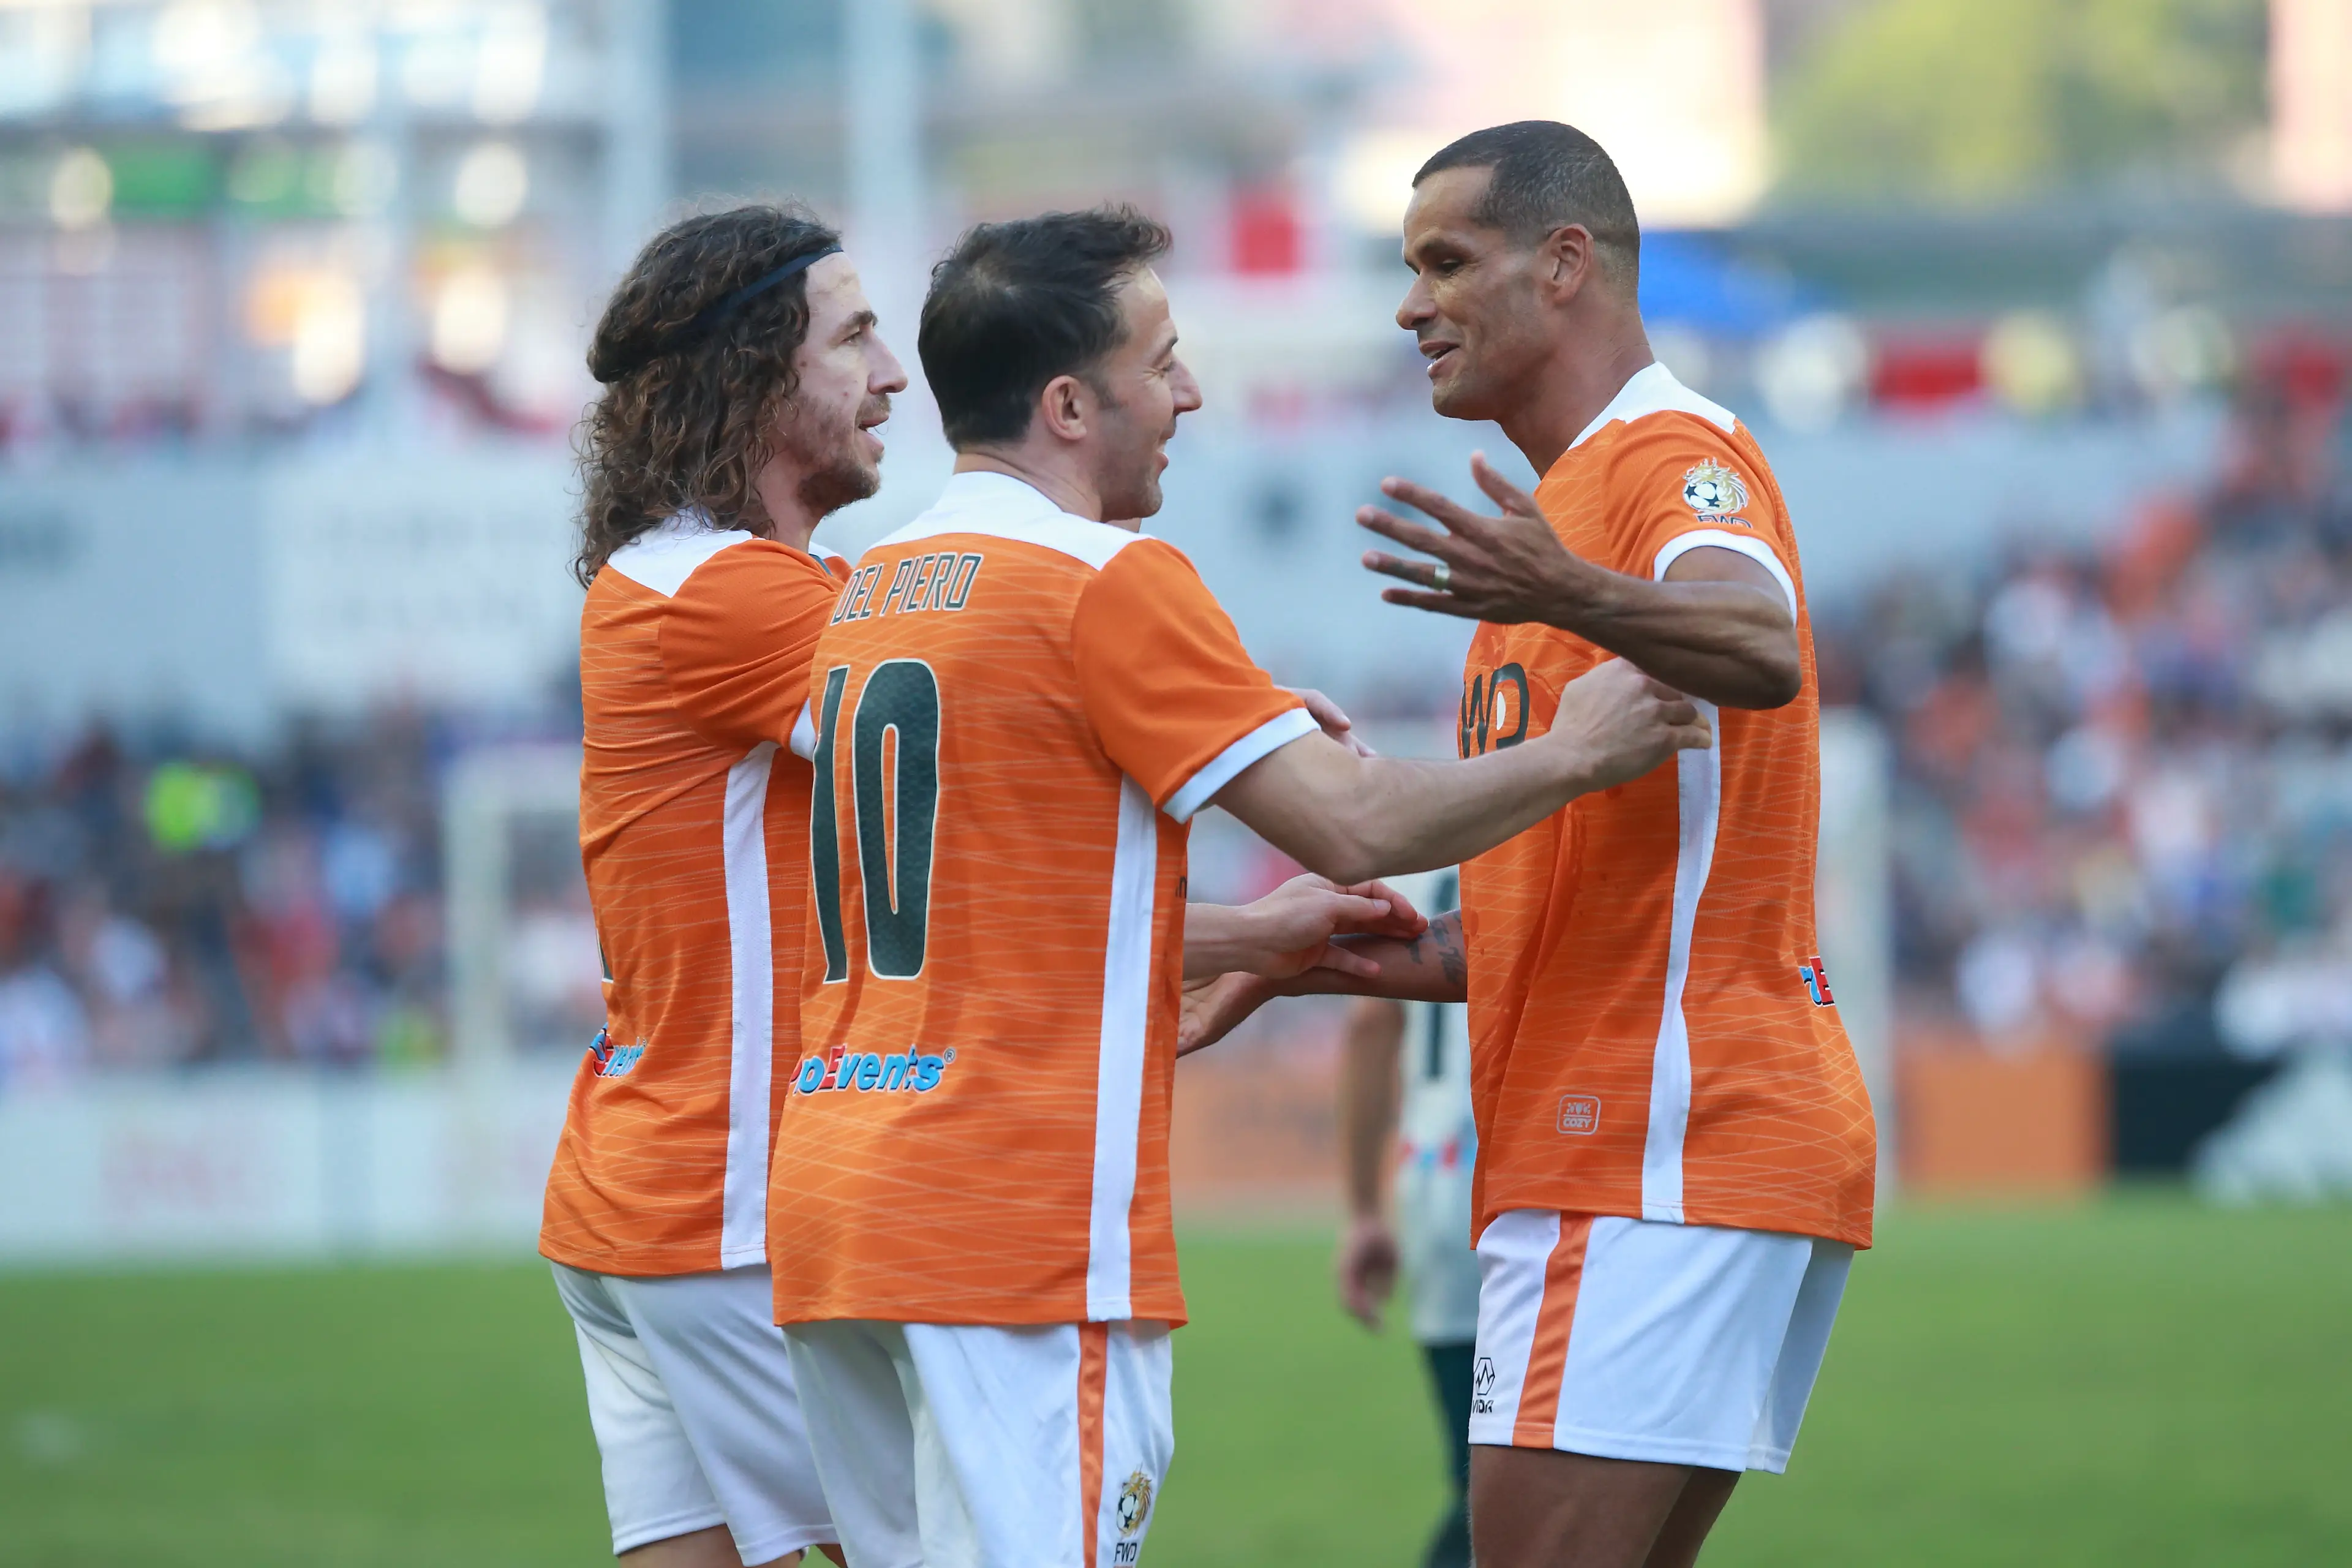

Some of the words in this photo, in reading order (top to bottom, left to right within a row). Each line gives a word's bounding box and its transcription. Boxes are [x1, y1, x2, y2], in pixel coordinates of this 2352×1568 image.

[829, 563, 884, 626] DEL
[879, 552, 985, 616] PIERO
[810, 658, 942, 984] 10
[1114, 1542, 1137, 1562] FWD
